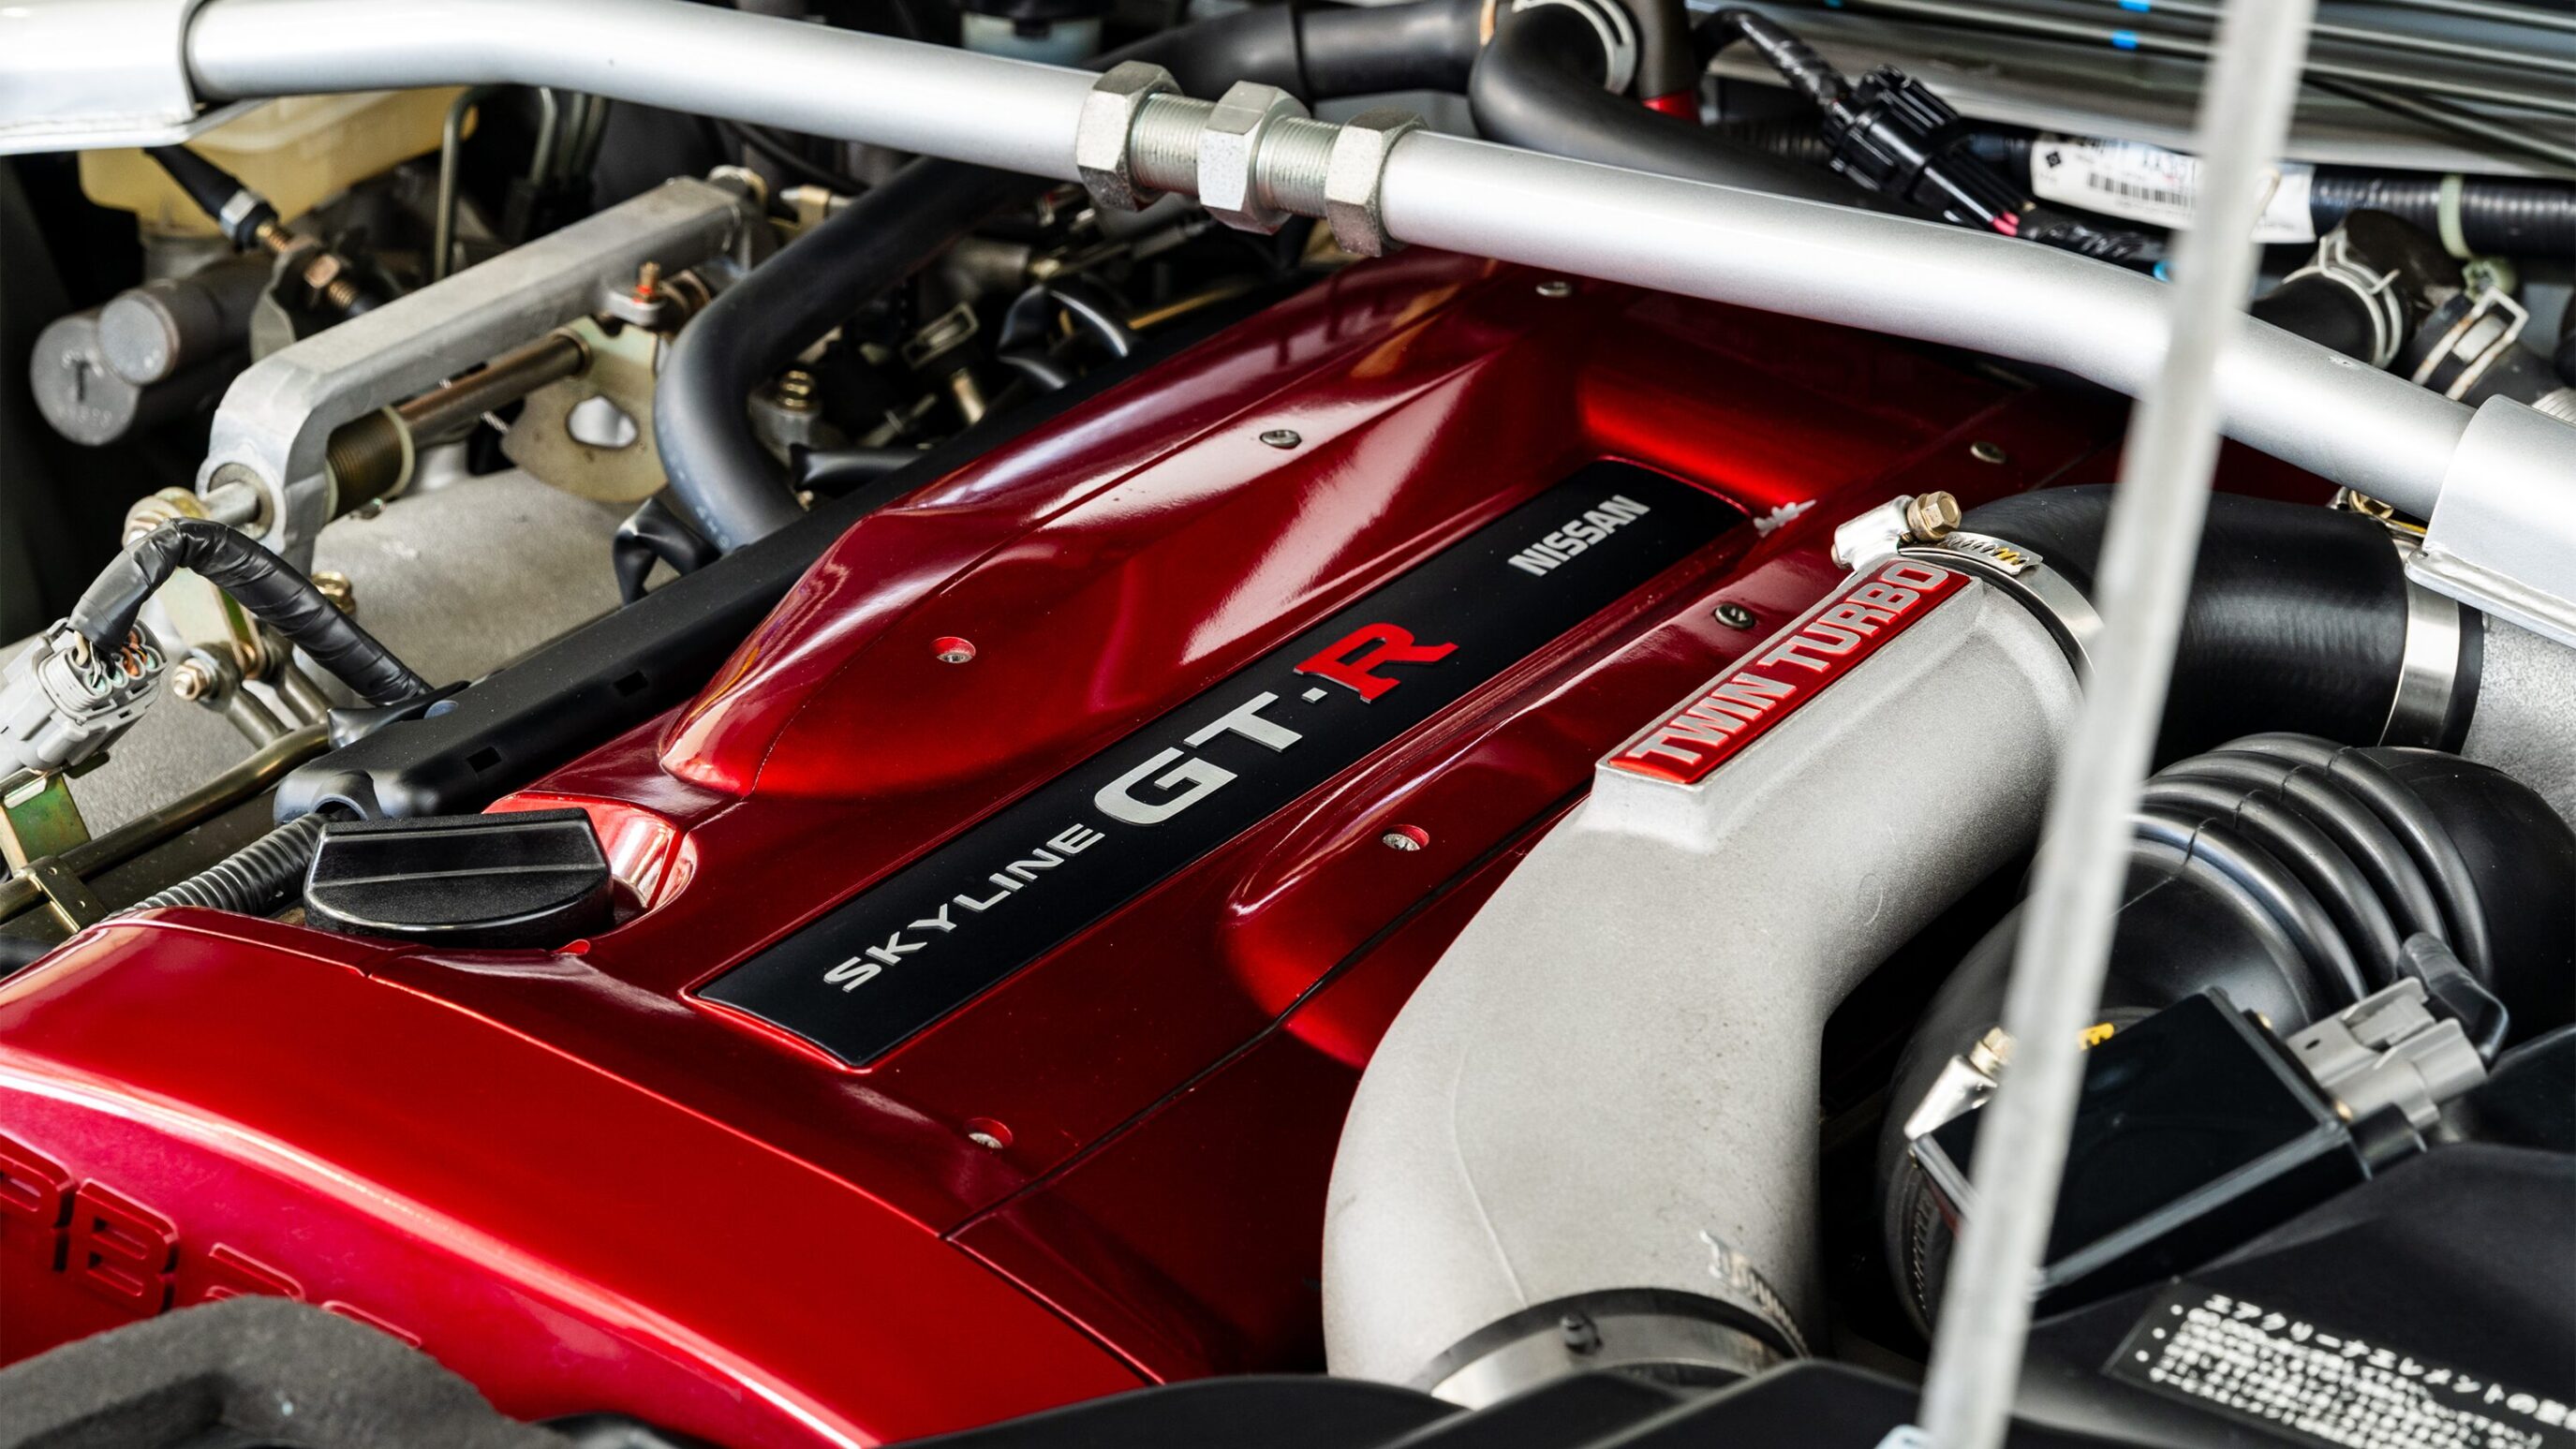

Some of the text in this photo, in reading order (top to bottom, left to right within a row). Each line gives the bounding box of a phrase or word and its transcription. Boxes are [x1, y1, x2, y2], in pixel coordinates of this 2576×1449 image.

[1507, 495, 1651, 577] NISSAN
[1625, 561, 1949, 765] TWIN TURBO
[823, 823, 1105, 993] SKYLINE
